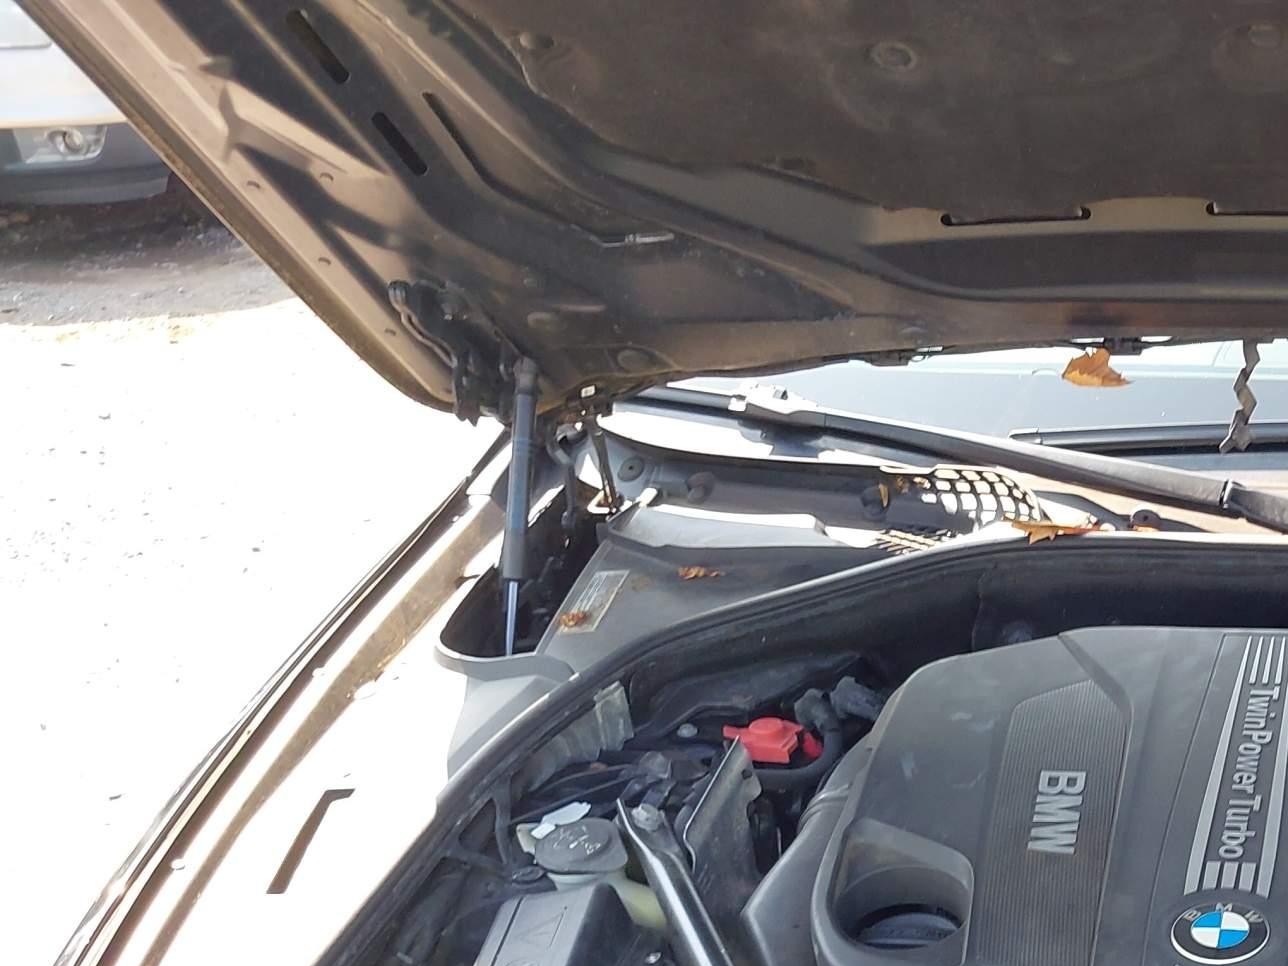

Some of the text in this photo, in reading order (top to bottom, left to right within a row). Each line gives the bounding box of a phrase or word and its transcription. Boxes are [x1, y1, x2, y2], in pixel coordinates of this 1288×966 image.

[1027, 770, 1087, 855] BMW
[1218, 795, 1263, 859] Turbo
[1183, 902, 1264, 923] BMW
